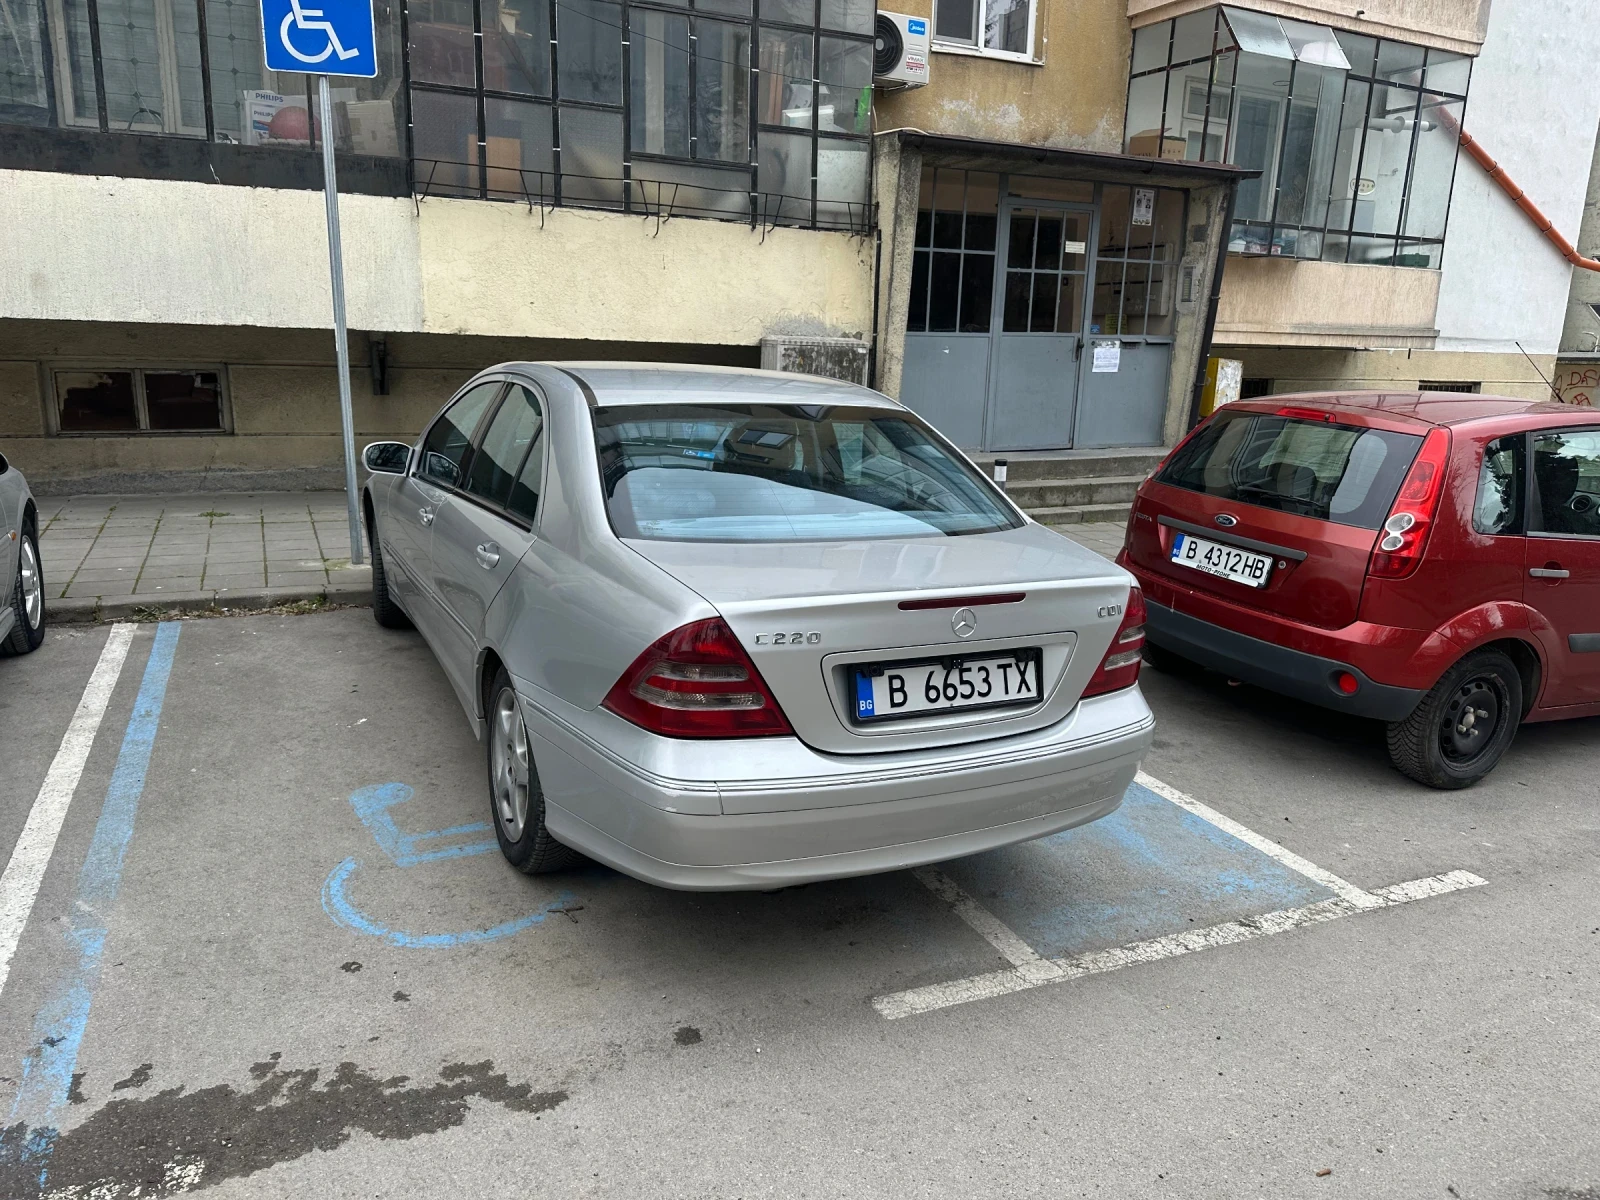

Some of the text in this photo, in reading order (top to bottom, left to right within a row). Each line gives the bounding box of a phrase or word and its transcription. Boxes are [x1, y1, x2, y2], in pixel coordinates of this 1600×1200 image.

[255, 92, 284, 102] PHILIPS
[1172, 548, 1180, 557] BG
[1185, 540, 1198, 560] B
[1097, 604, 1121, 618] CDI
[888, 674, 908, 708] B
[859, 700, 873, 710] BG
